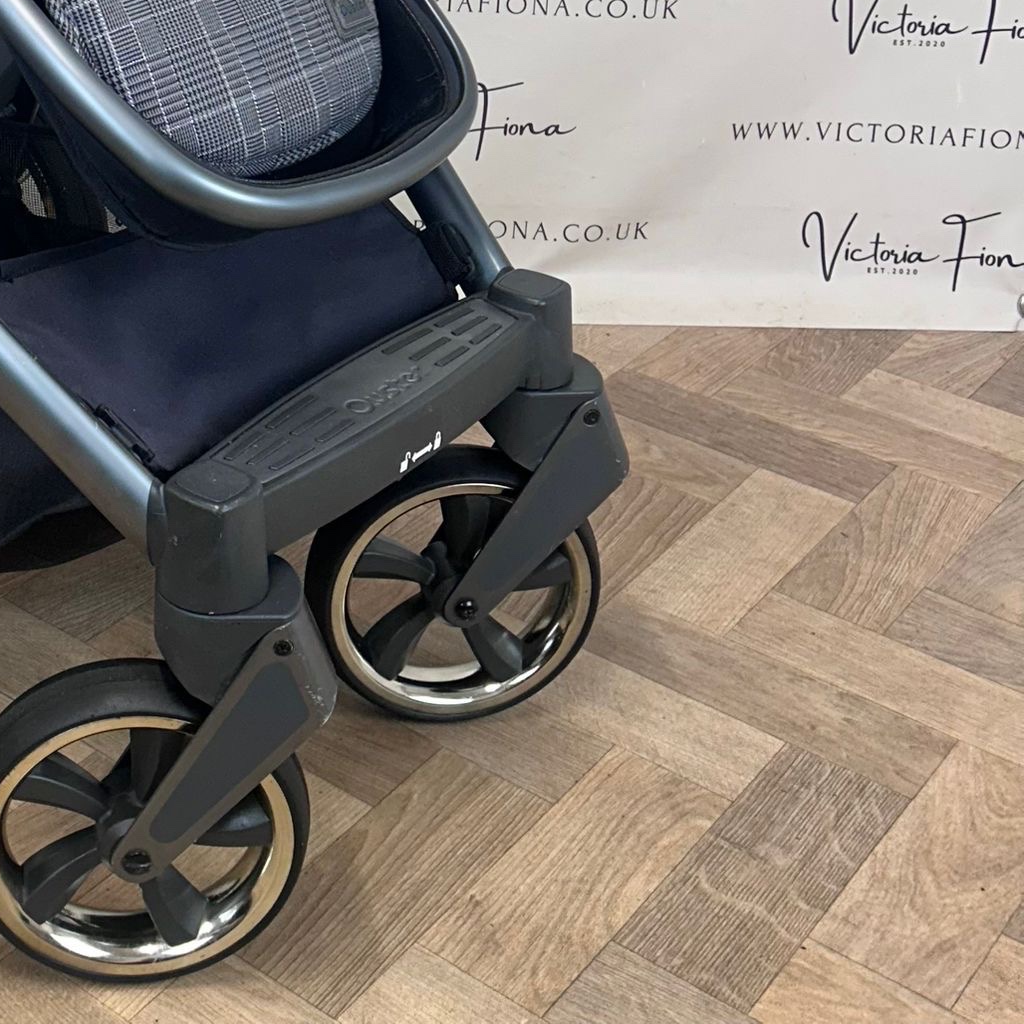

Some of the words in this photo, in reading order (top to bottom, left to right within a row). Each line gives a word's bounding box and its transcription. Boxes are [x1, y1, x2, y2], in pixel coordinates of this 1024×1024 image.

[893, 39, 945, 47] EST.2020
[802, 211, 940, 282] Victoria
[867, 267, 918, 275] EST.2020
